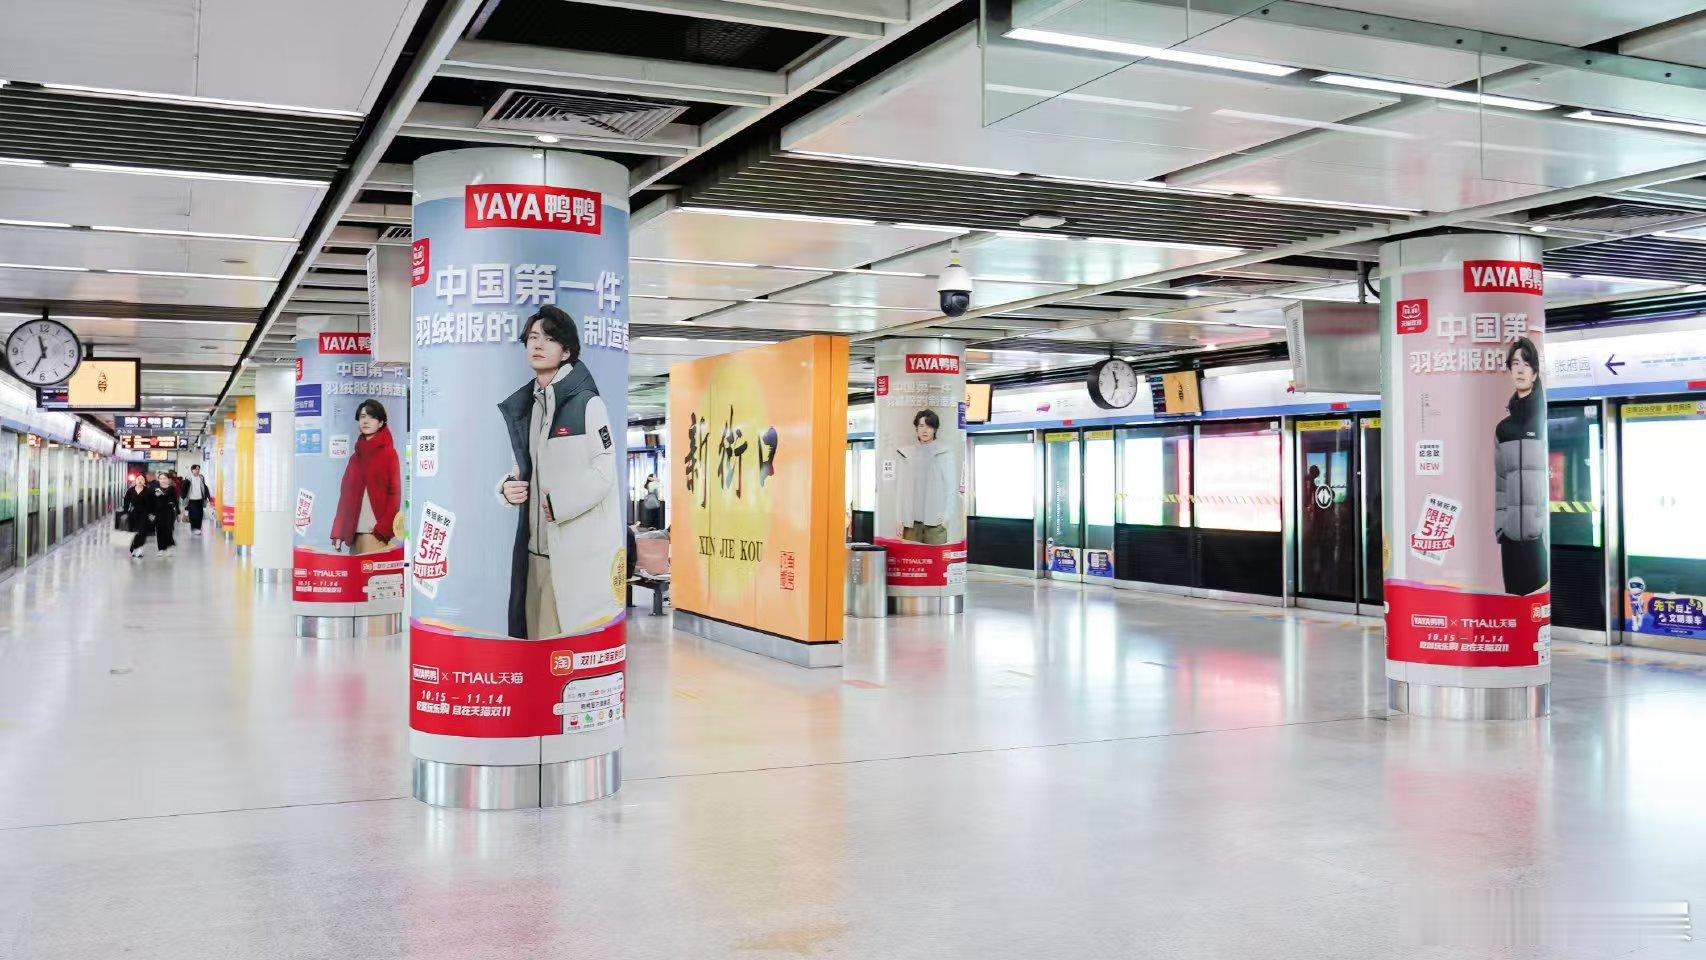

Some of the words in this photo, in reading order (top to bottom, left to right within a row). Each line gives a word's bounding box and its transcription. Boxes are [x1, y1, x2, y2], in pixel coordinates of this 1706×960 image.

[473, 192, 596, 227] YAYA鸭鸭
[1470, 266, 1543, 291] YAYA鸭鸭
[436, 263, 624, 312] 中国第一件
[40, 324, 50, 333] 12
[415, 311, 519, 346] 羽绒服的
[68, 349, 75, 358] 3
[909, 357, 959, 371] YAYA鸭鸭
[1408, 349, 1507, 374] 羽绒服的
[40, 372, 46, 382] 6
[684, 404, 778, 509] 新街口
[419, 460, 435, 470] NEW
[1419, 462, 1440, 471] NEW
[1425, 507, 1454, 526] 限时
[422, 521, 447, 546] 限时
[1421, 520, 1449, 539] 5折
[419, 538, 442, 564] 5折
[699, 535, 716, 556] XIN
[719, 538, 735, 560] JIE
[740, 540, 763, 562] KOU
[1654, 599, 1693, 614] 先下后上
[1460, 618, 1517, 629] TMALL天猫
[1669, 613, 1703, 626] 文明乘车
[1427, 632, 1456, 641] 10.15
[1473, 635, 1504, 643] 11.14
[553, 656, 572, 670] 淘
[452, 671, 524, 685] TMALL天猫
[421, 690, 447, 703] 10.15
[467, 693, 504, 704] 11.14
